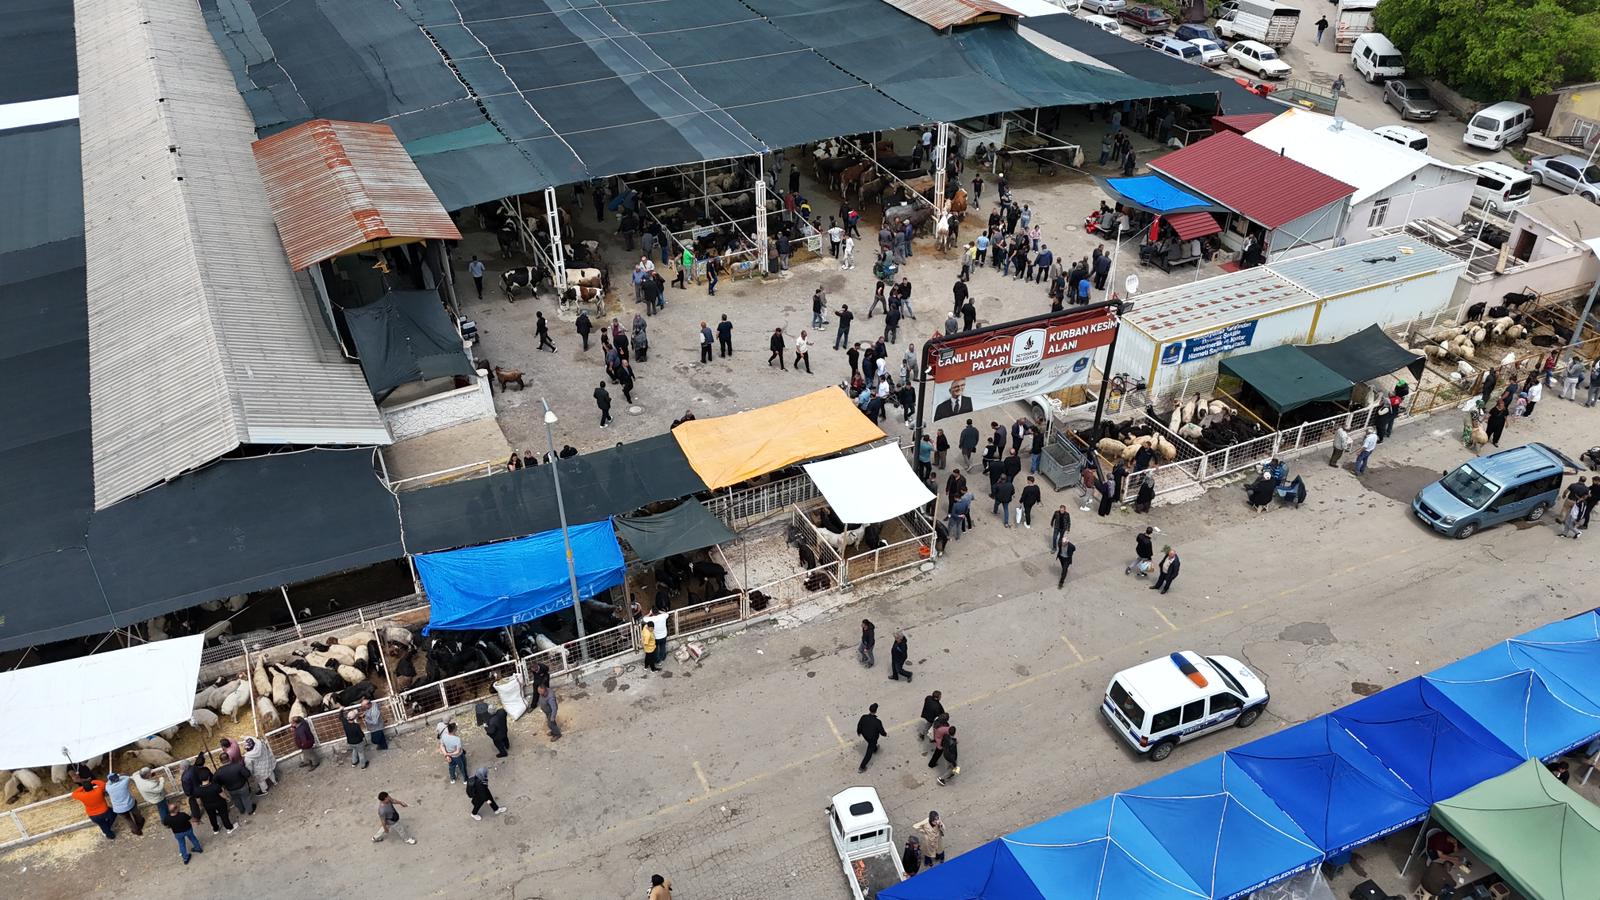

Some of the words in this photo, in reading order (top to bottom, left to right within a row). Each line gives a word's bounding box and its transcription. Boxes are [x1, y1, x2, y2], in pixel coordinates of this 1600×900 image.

[1049, 325, 1089, 342] KURBAN
[1090, 319, 1117, 333] KESİM
[938, 352, 967, 367] CANLI
[970, 343, 1011, 360] HAYVAN
[1048, 340, 1078, 354] ALANI
[972, 355, 1009, 371] PAZARI
